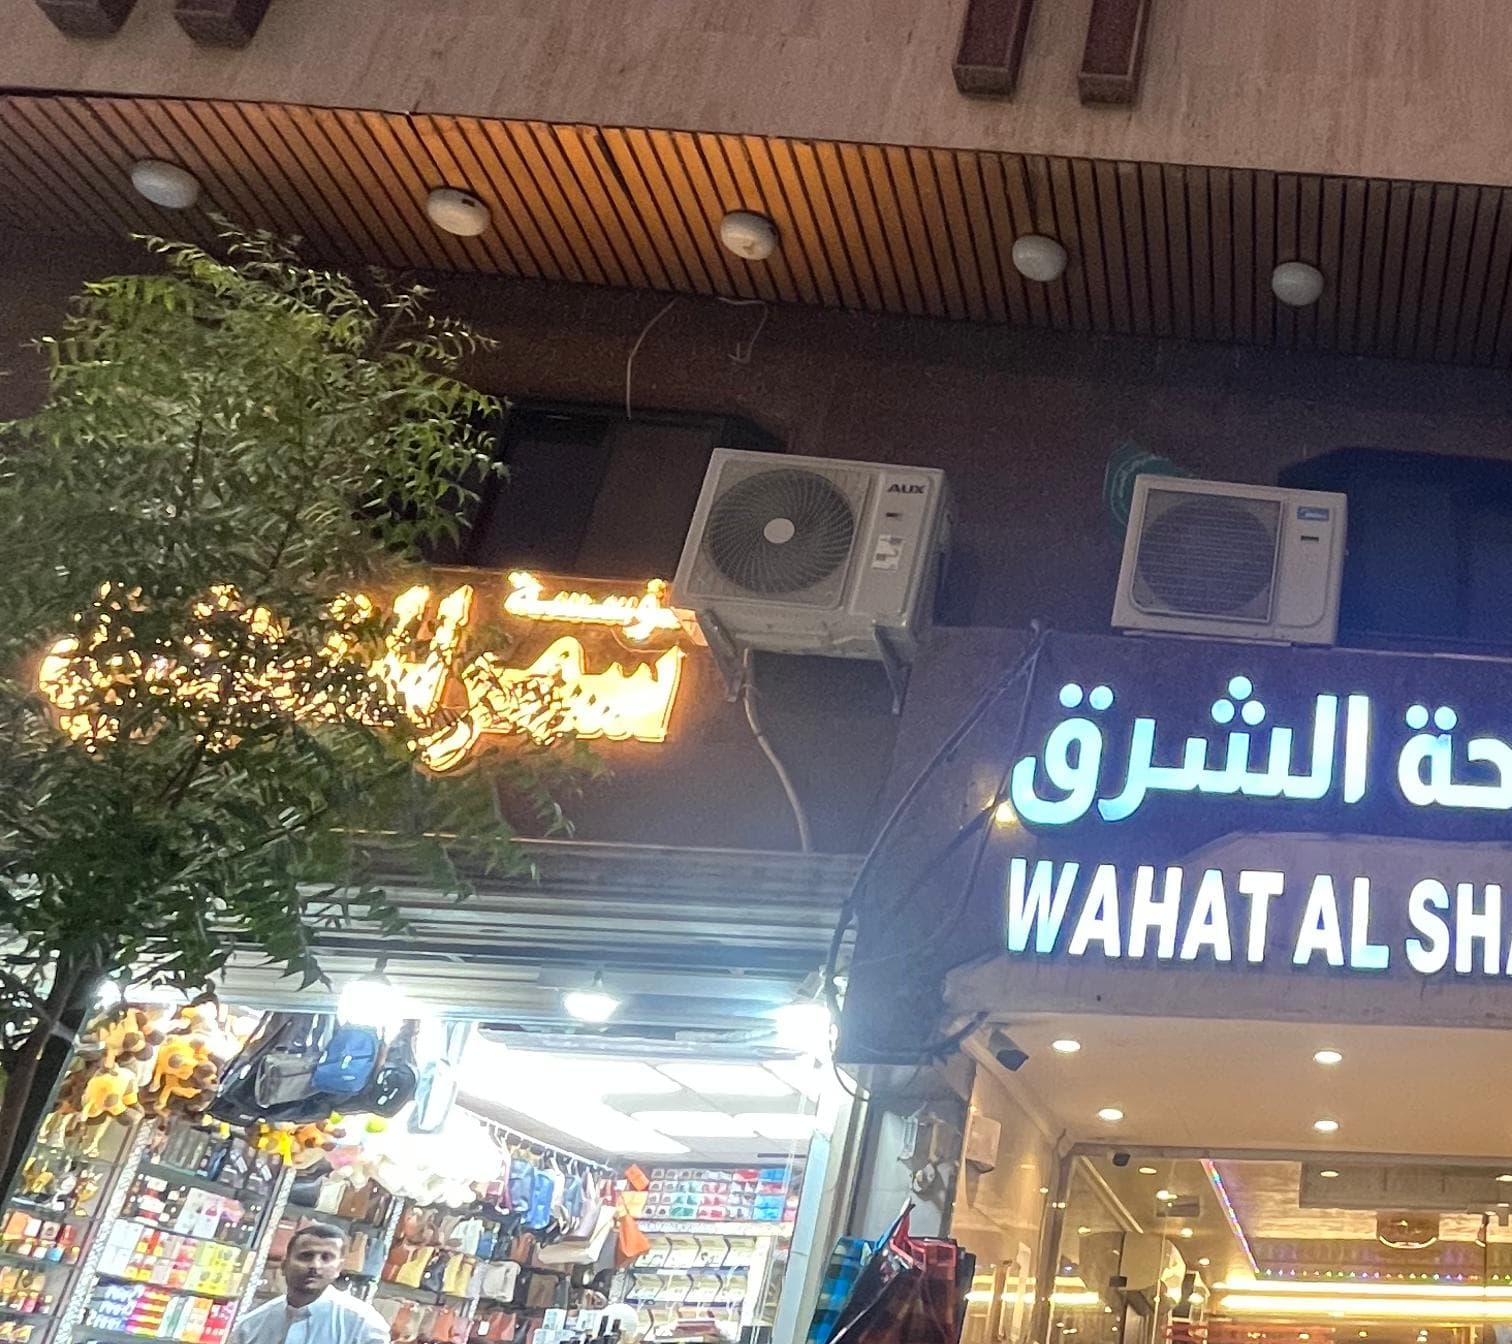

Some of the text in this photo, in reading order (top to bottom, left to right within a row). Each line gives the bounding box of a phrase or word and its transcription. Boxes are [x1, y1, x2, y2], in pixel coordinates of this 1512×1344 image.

[886, 483, 926, 494] AUX
[1010, 675, 1370, 825] الشرق
[1008, 858, 1285, 962] WAHAT
[1292, 874, 1390, 969] AL
